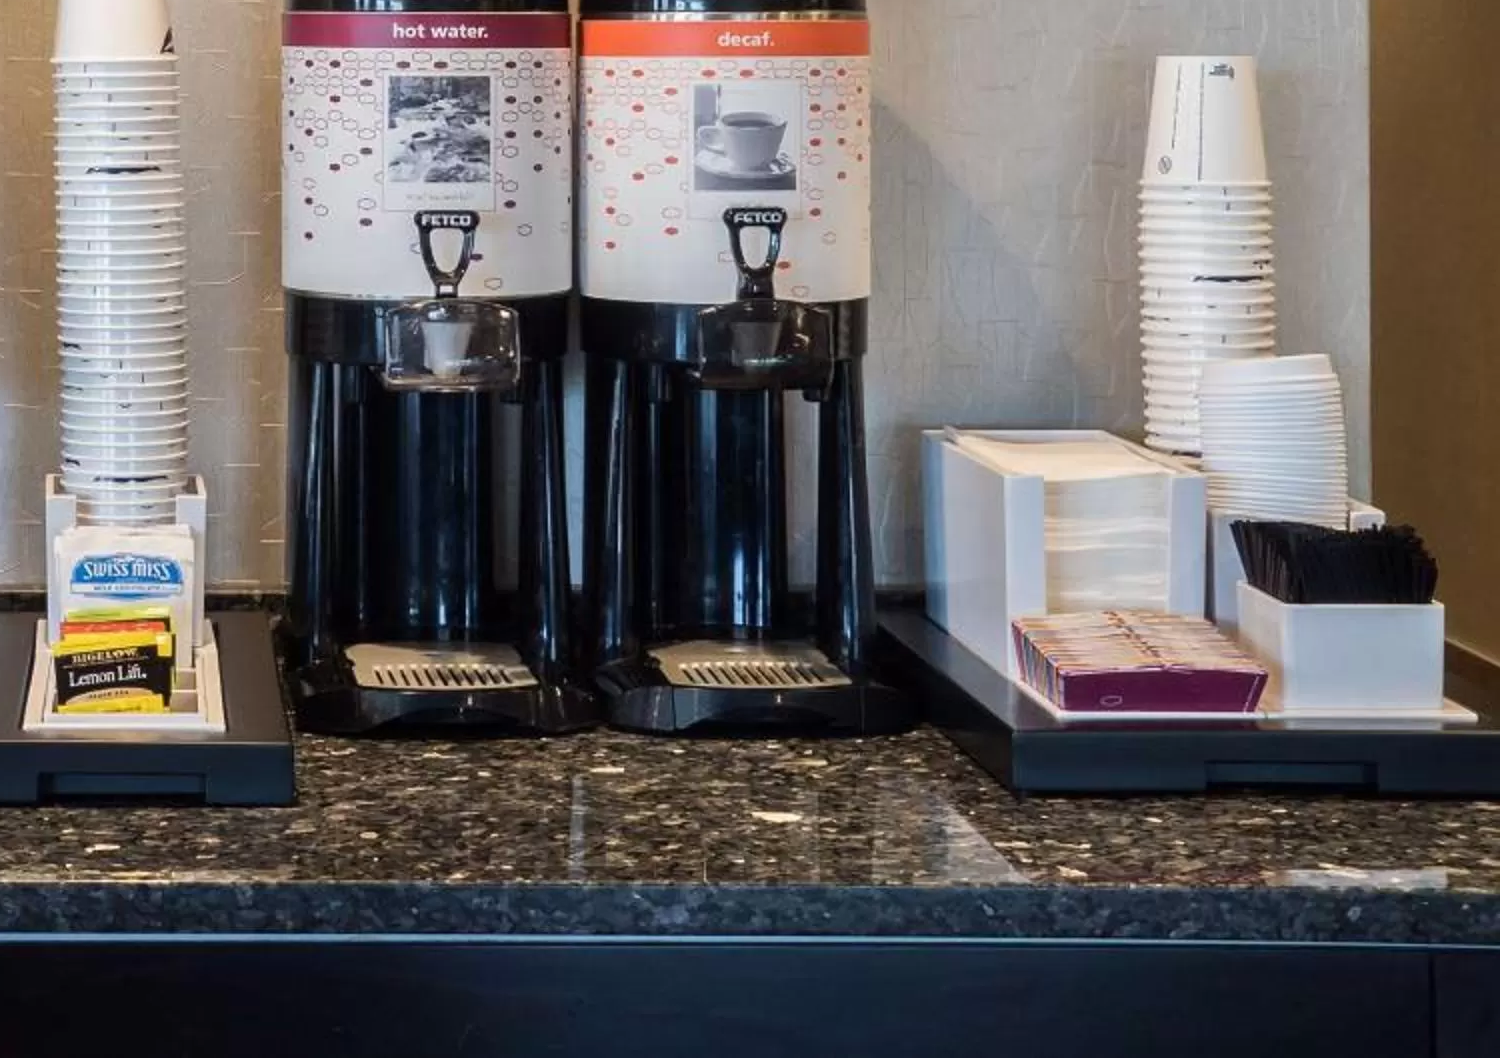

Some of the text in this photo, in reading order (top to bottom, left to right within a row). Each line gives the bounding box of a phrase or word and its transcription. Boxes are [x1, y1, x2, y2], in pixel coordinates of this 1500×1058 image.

[393, 22, 489, 39] hot water.
[717, 30, 775, 47] decaf.
[421, 214, 471, 227] FETCO
[733, 212, 782, 224] FETCO
[68, 670, 116, 688] Lemon
